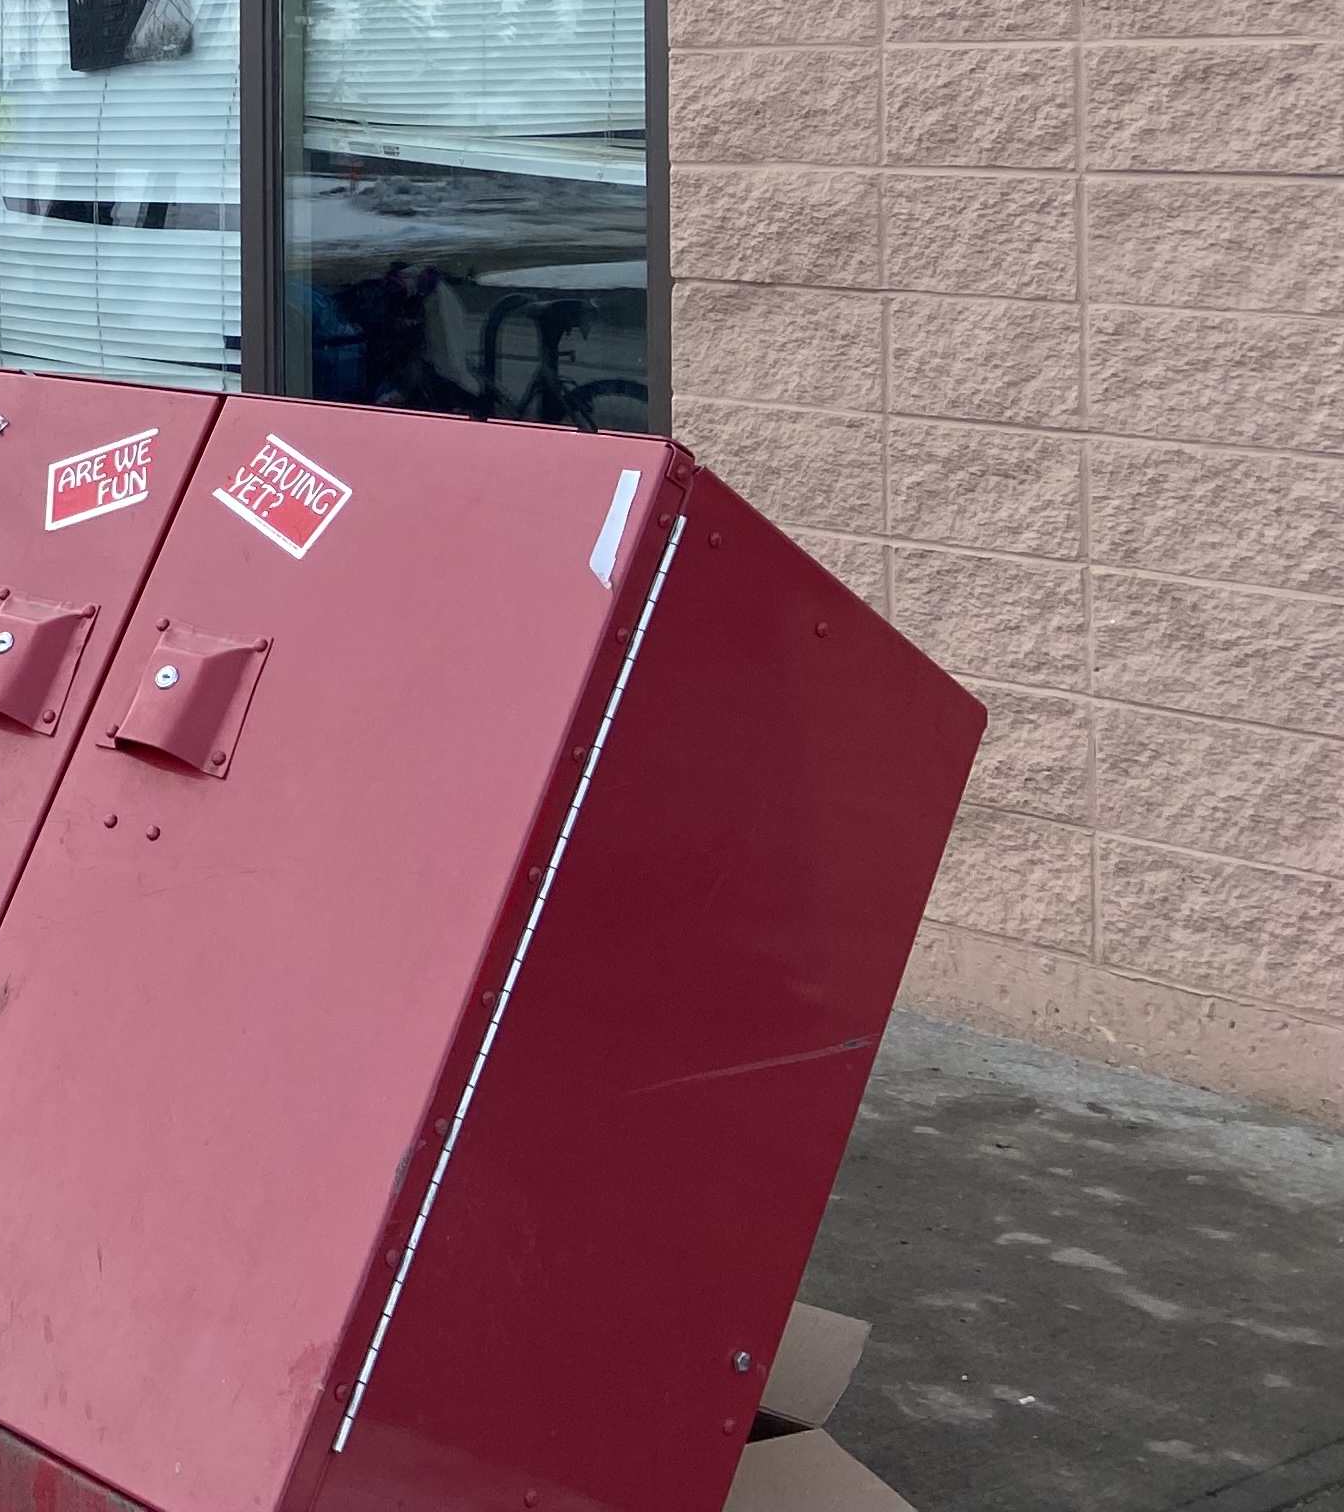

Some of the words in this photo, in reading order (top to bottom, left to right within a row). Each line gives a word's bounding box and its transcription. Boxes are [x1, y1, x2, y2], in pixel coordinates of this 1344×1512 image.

[58, 454, 108, 493] ARE
[114, 438, 152, 473] WE
[97, 467, 147, 505] FUN
[228, 466, 285, 517] YET?
[249, 444, 338, 515] HAVING
